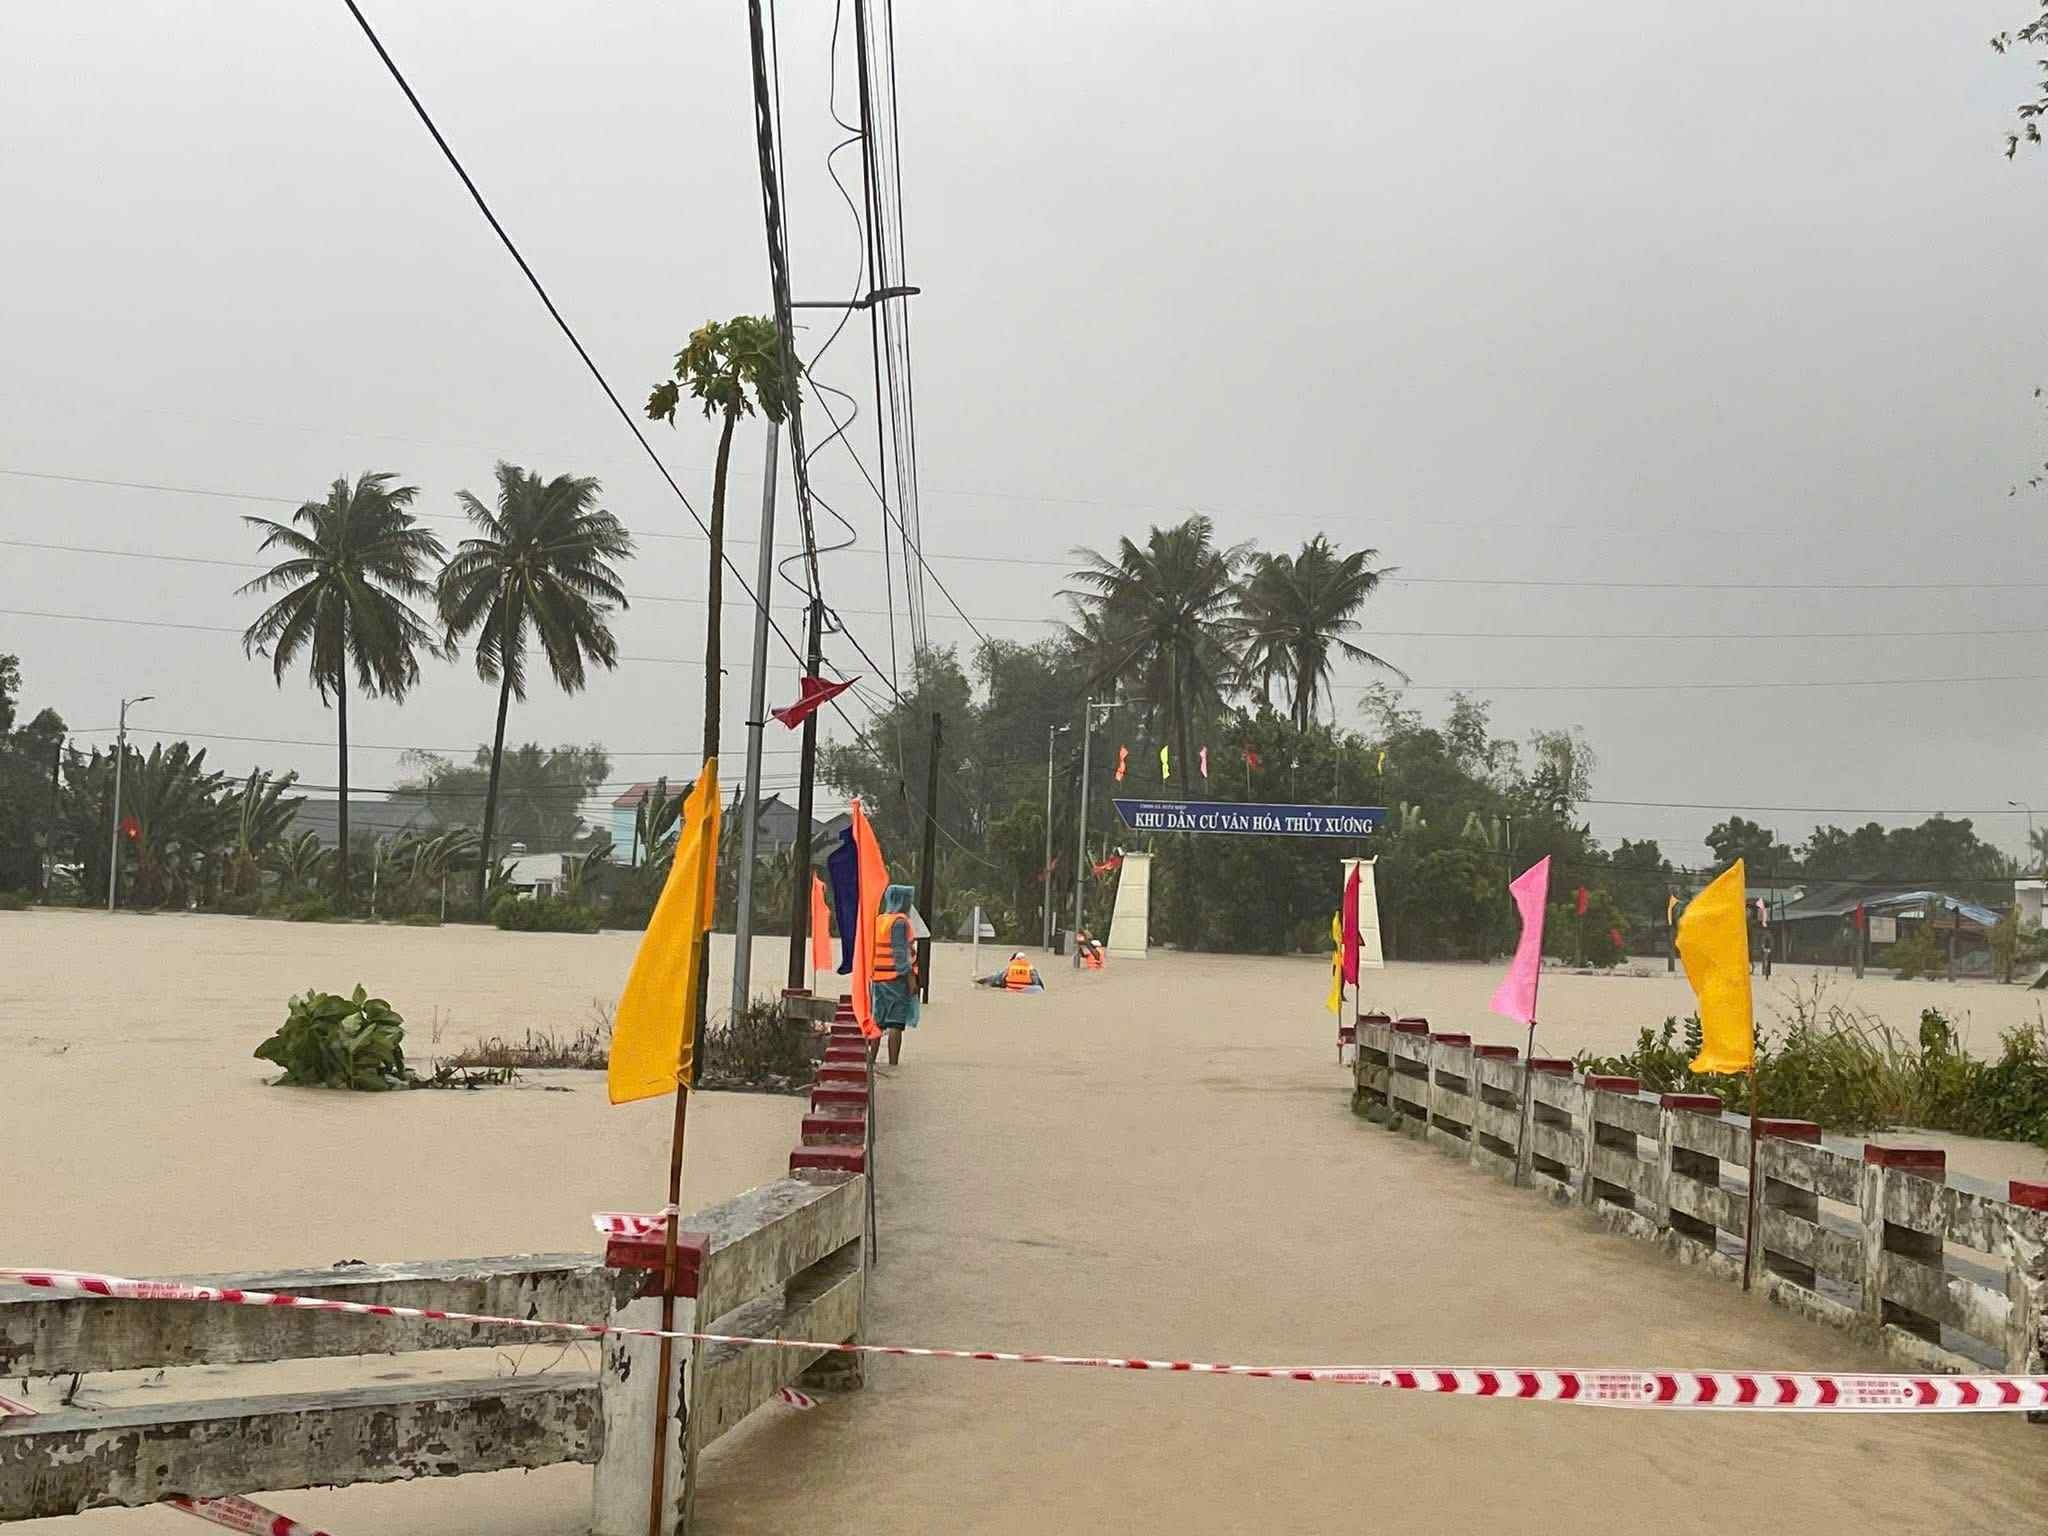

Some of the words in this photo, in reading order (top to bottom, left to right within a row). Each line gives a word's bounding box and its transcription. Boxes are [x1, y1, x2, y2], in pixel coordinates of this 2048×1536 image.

[1136, 813, 1164, 828] KHU
[1167, 810, 1196, 829] DÂN
[1199, 812, 1219, 829] CƯ
[1253, 812, 1281, 831] HÓA
[1284, 812, 1322, 832] THỦY
[1325, 815, 1373, 833] XƯƠNG
